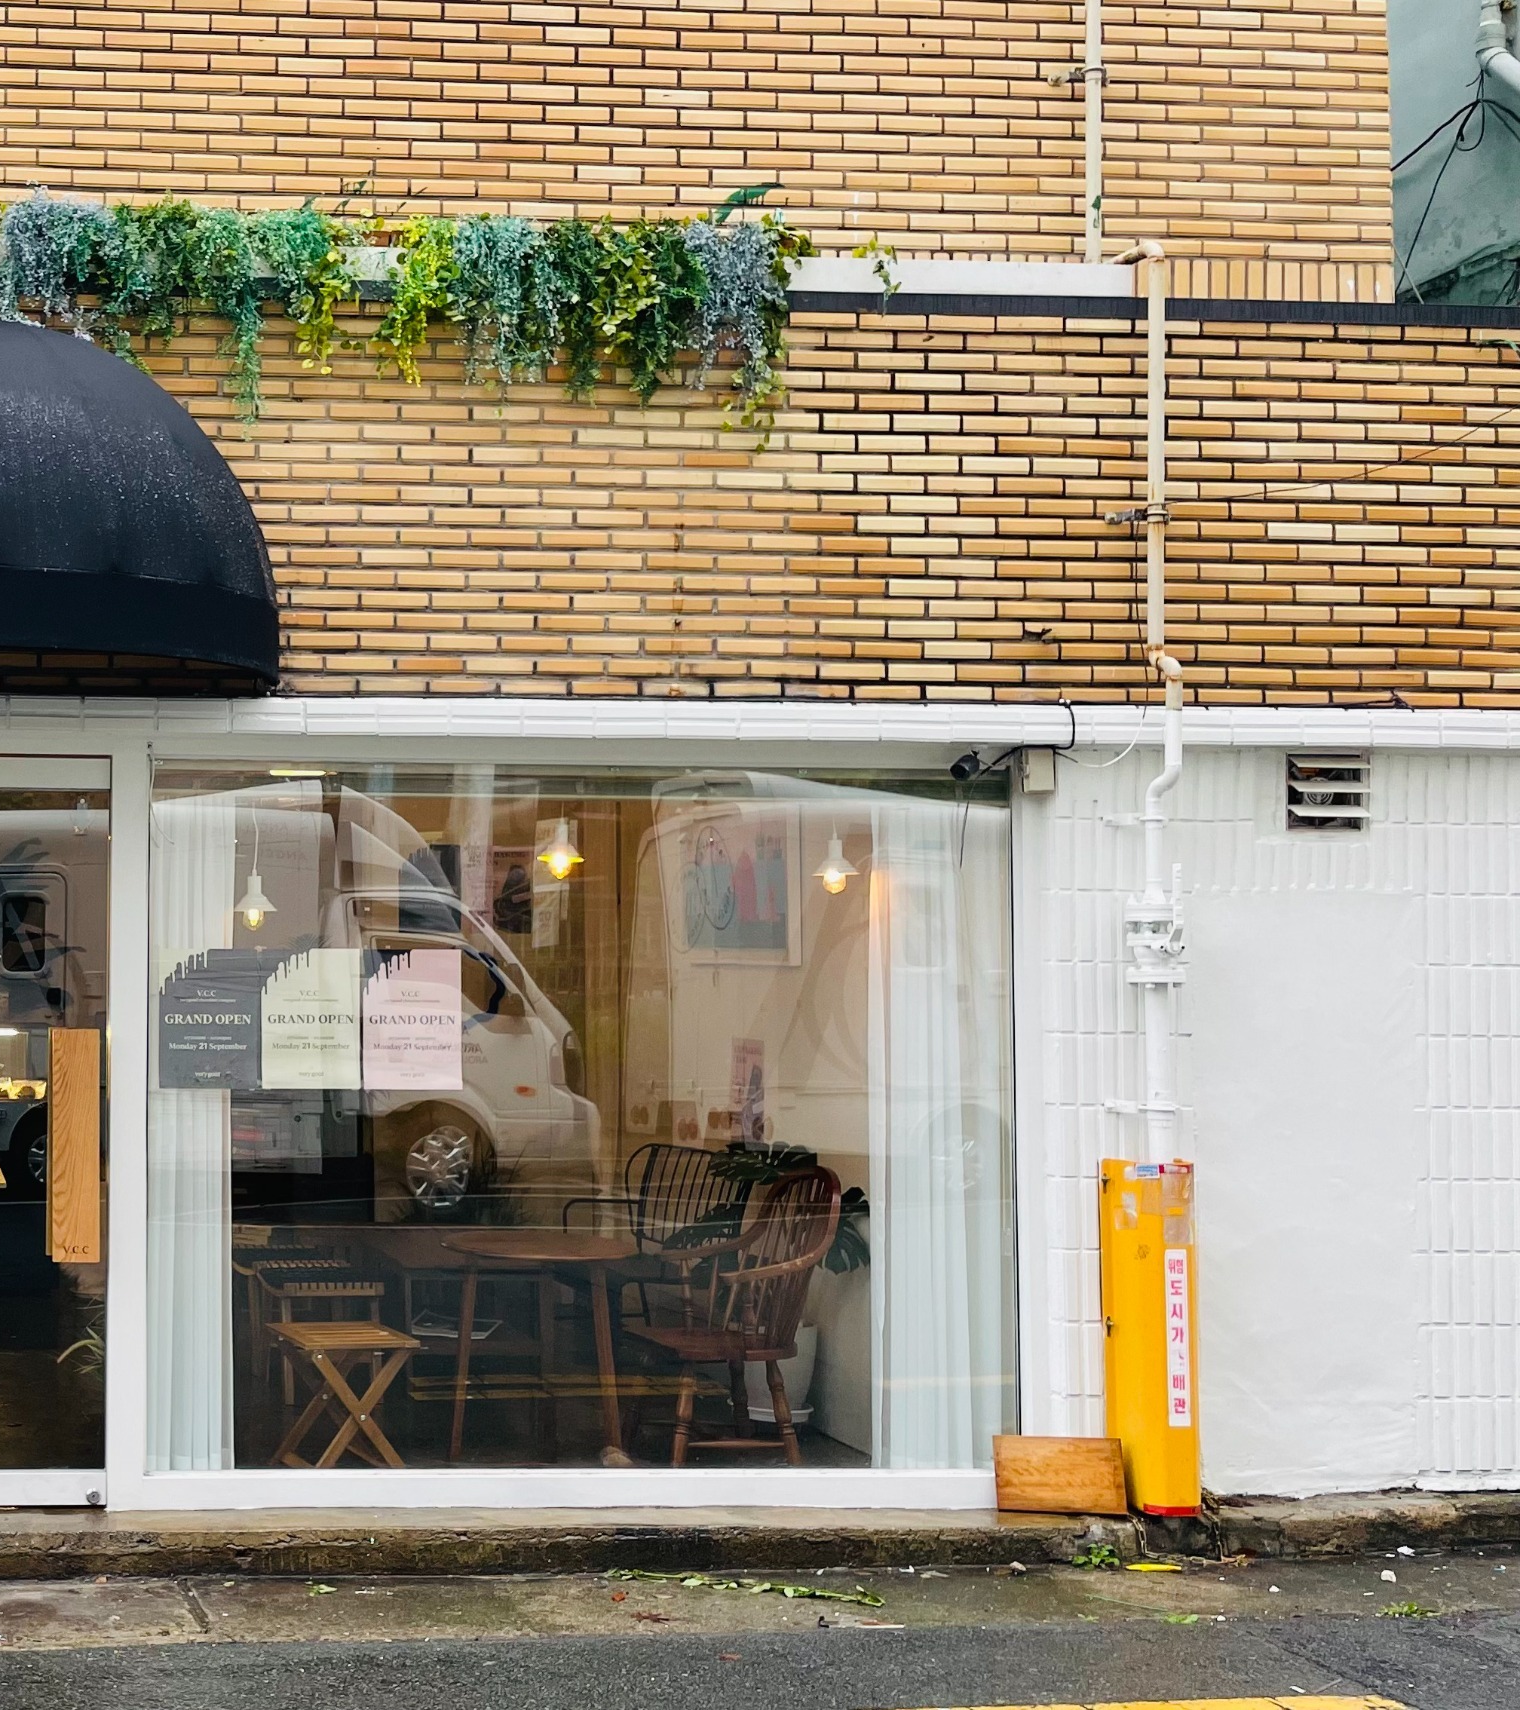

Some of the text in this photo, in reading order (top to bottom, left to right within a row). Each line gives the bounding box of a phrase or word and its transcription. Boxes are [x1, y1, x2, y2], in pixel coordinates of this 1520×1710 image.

[196, 989, 217, 997] V.C.C
[164, 1013, 252, 1025] GRAND OPEN
[267, 1013, 355, 1025] GRAND OPEN
[368, 1014, 456, 1025] GRAND OPEN
[168, 1042, 248, 1051] Monday 21 September
[271, 1042, 350, 1051] Monday 21 September
[373, 1043, 401, 1051] Monday
[413, 1043, 452, 1051] September
[1168, 1258, 1184, 1275] 위험
[1170, 1279, 1186, 1414] 도시가배관
